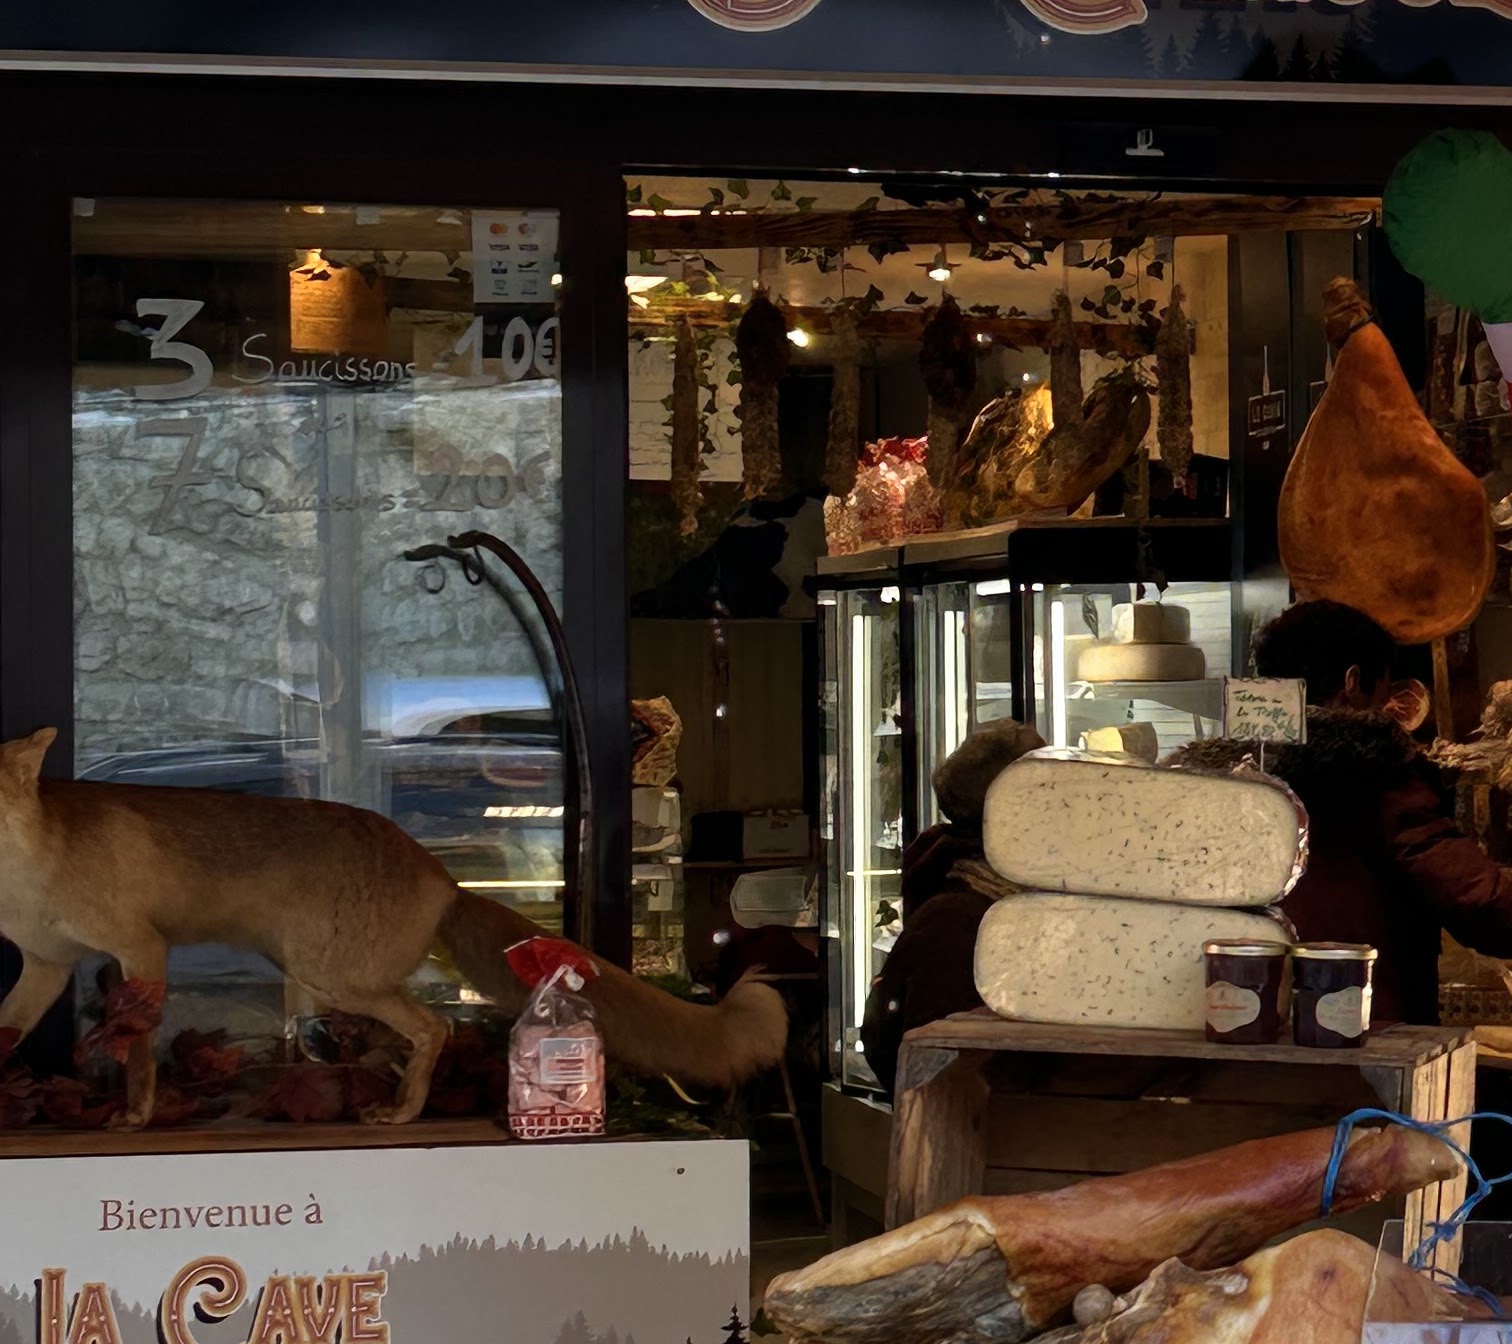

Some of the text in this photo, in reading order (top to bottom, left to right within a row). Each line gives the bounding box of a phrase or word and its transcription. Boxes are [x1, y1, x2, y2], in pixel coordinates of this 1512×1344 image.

[134, 298, 213, 400] 3
[135, 417, 222, 536] 7
[99, 1193, 324, 1231] Bienvenue à
